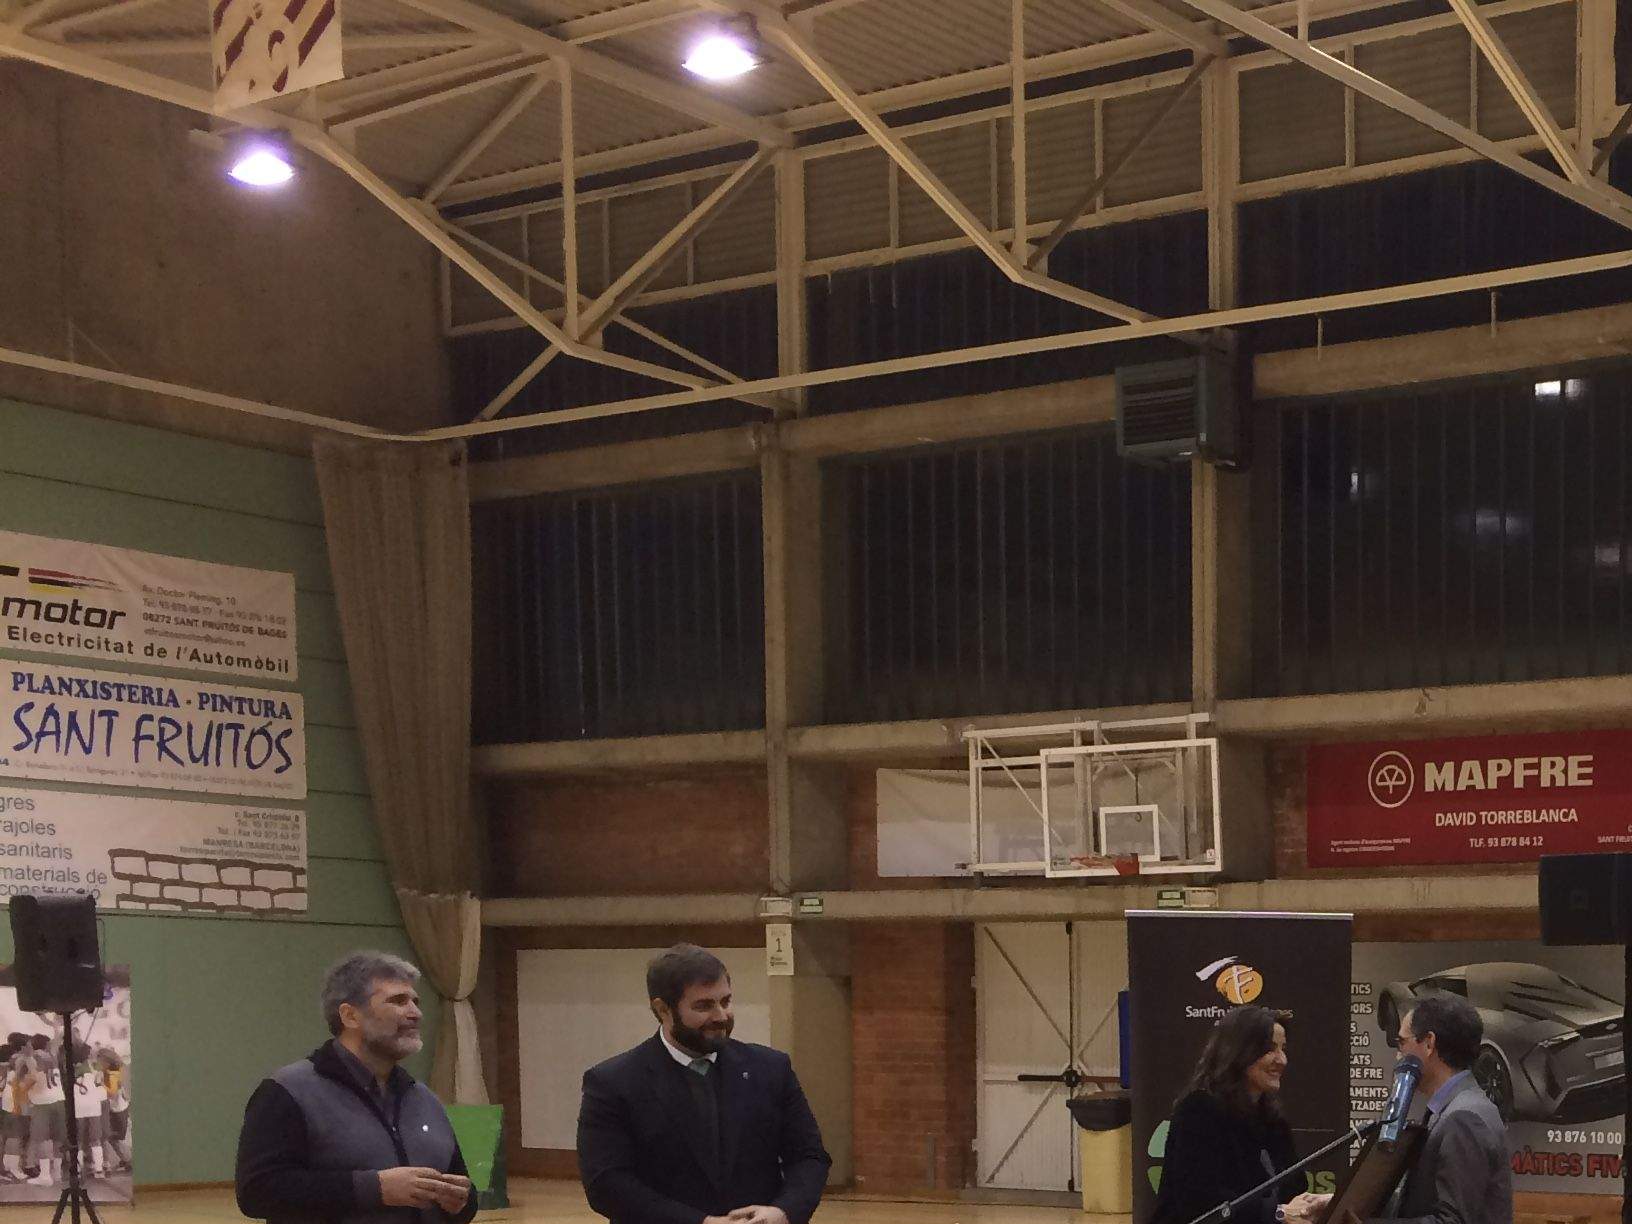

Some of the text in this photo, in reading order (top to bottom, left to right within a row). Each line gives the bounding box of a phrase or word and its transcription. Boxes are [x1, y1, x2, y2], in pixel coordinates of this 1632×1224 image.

[1, 596, 127, 630] motor
[7, 625, 134, 654] Electricitat
[143, 642, 168, 659] de
[11, 671, 293, 721] PLANXISTERIA PINTURA
[13, 701, 120, 758] SANT
[132, 713, 293, 775] FRUITÓS
[1424, 754, 1594, 792] MAPFRE
[1435, 808, 1579, 827] DAVID TORREBLANCA
[1487, 837, 1499, 847] 93
[1532, 835, 1543, 847] 12
[0, 843, 73, 861] sanitaris
[0, 865, 108, 885] materials de
[775, 937, 783, 953] 1
[1350, 1003, 1373, 1014] ORS
[1547, 1130, 1622, 1145] 93 876 10 00
[1586, 1153, 1628, 1179] FIV
